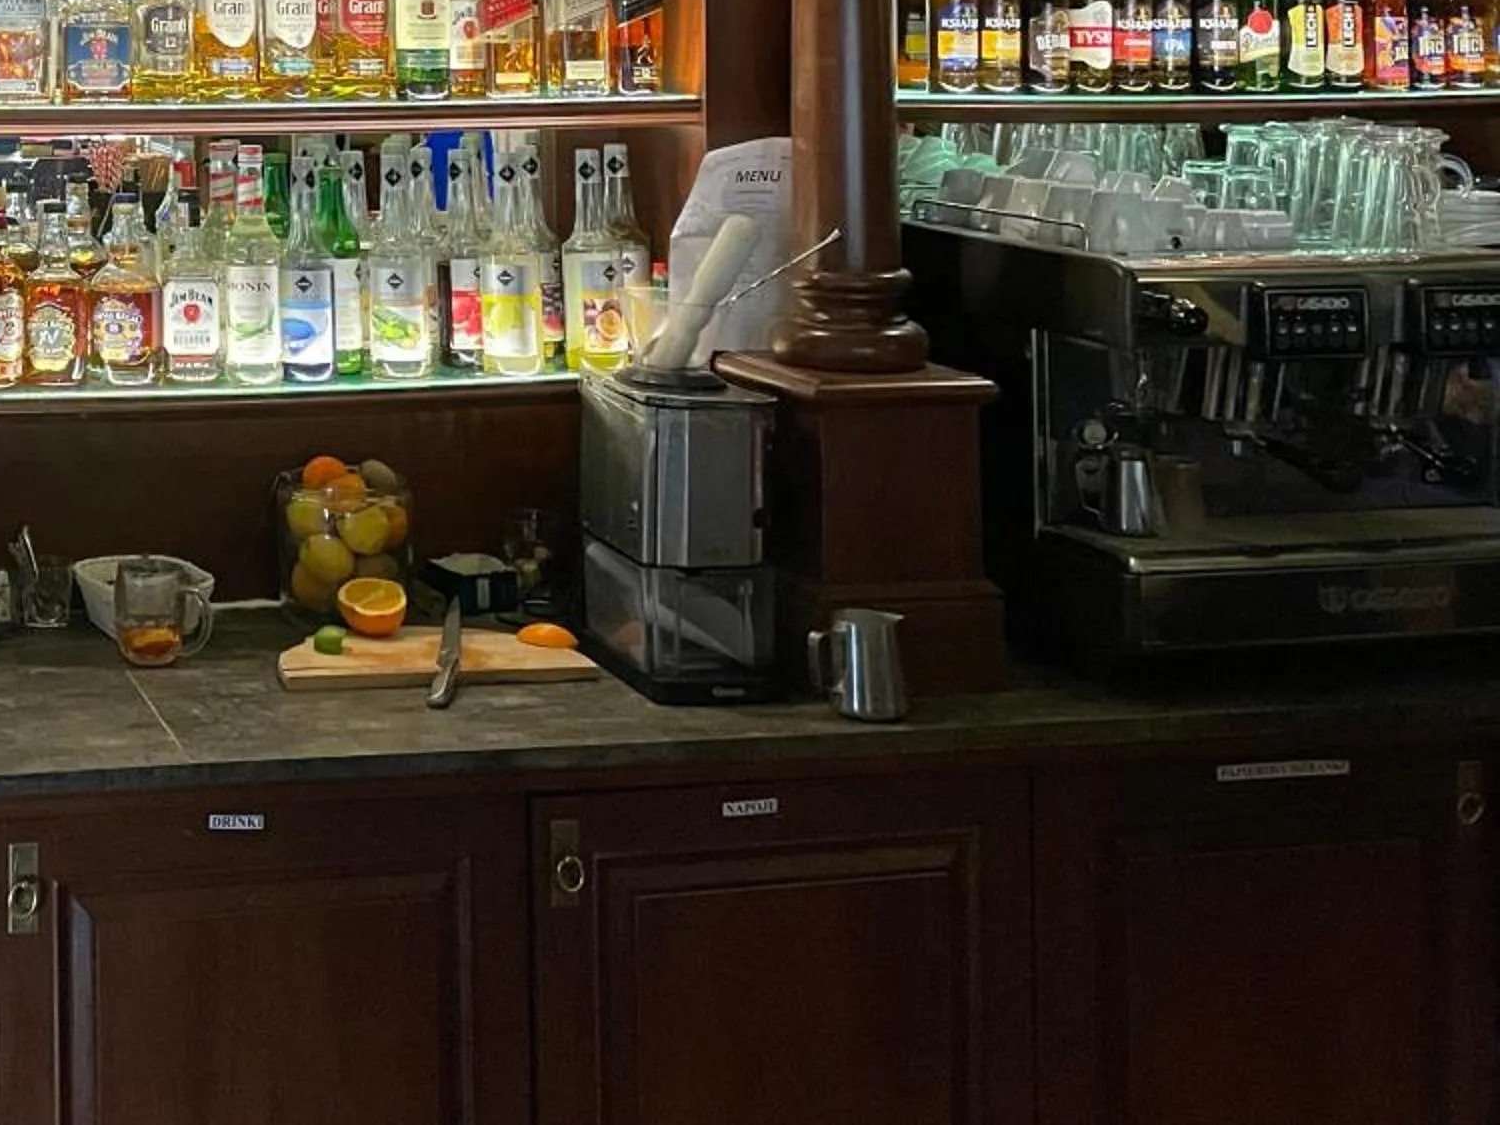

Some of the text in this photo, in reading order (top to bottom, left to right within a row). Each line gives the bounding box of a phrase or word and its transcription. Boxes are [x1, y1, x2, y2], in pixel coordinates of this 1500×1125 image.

[165, 36, 178, 48] 12
[735, 170, 782, 183] MENU
[170, 287, 213, 308] JIM BEAM
[211, 816, 261, 828] DRINKI
